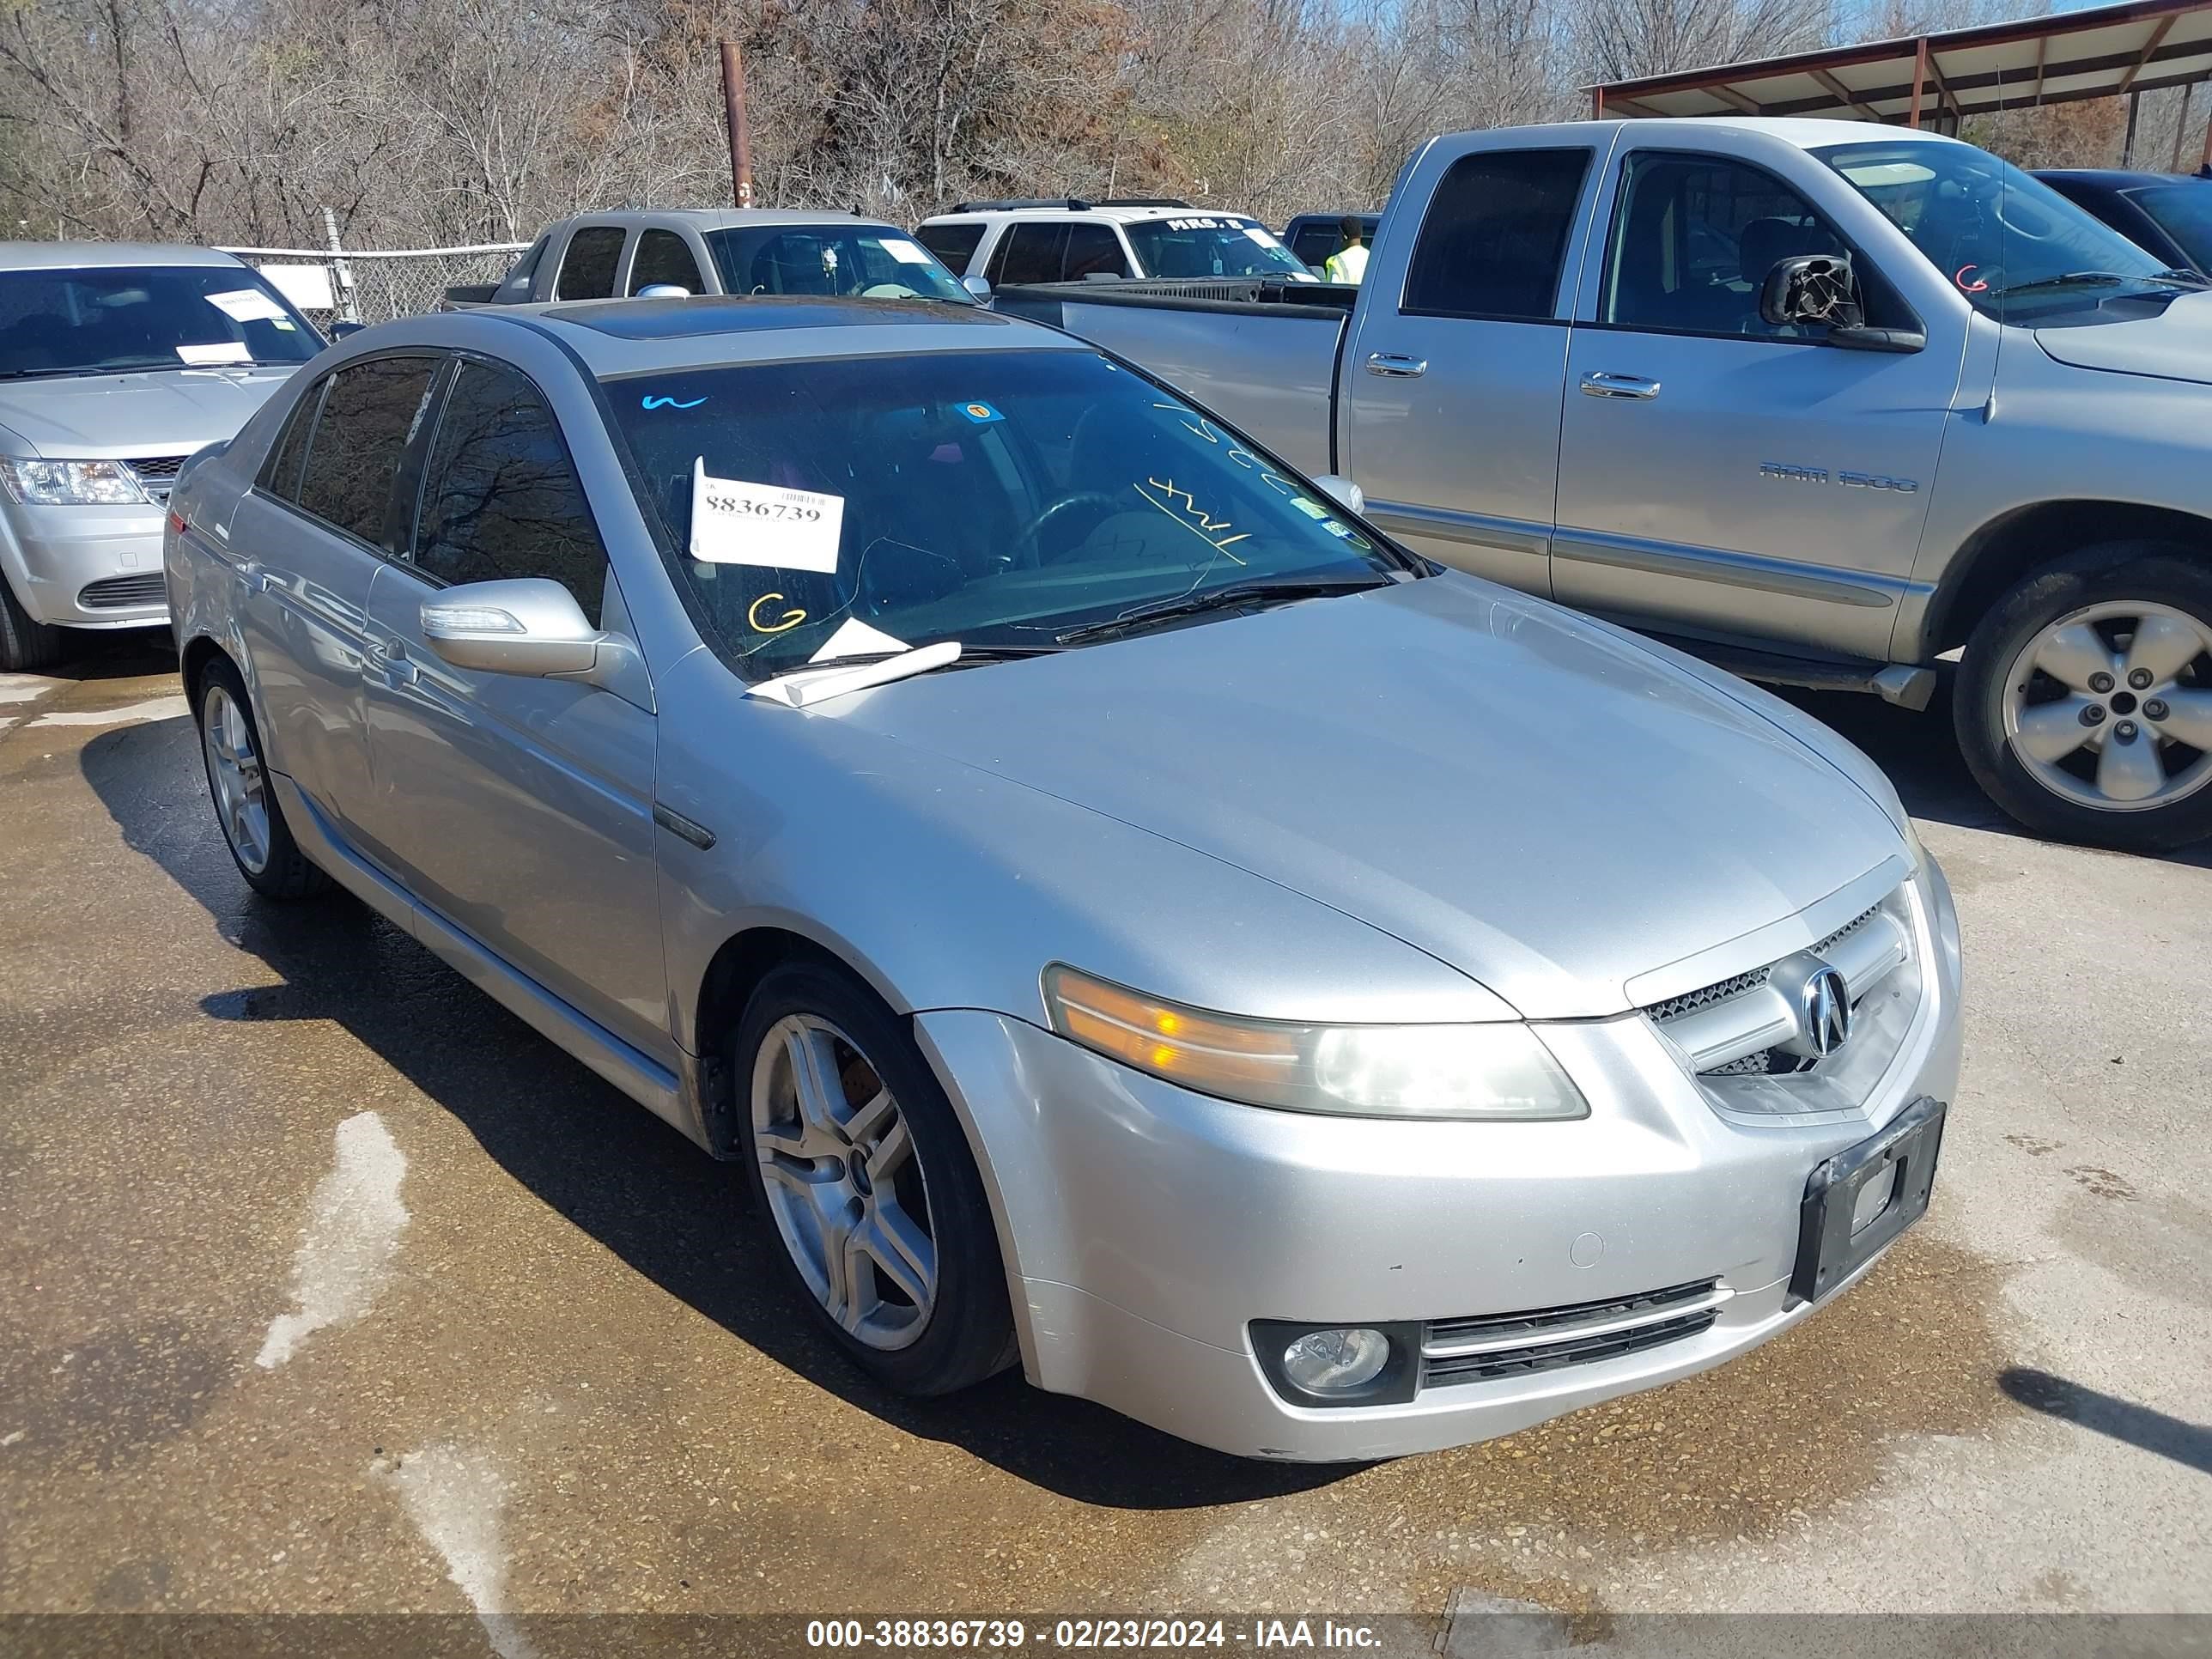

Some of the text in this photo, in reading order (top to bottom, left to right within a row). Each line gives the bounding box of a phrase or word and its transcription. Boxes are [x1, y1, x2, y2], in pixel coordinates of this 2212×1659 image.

[1166, 218, 1243, 232] MRS. B
[1759, 462, 1918, 495] RAM 1500
[706, 495, 821, 522] 8836739
[748, 592, 807, 633] G
